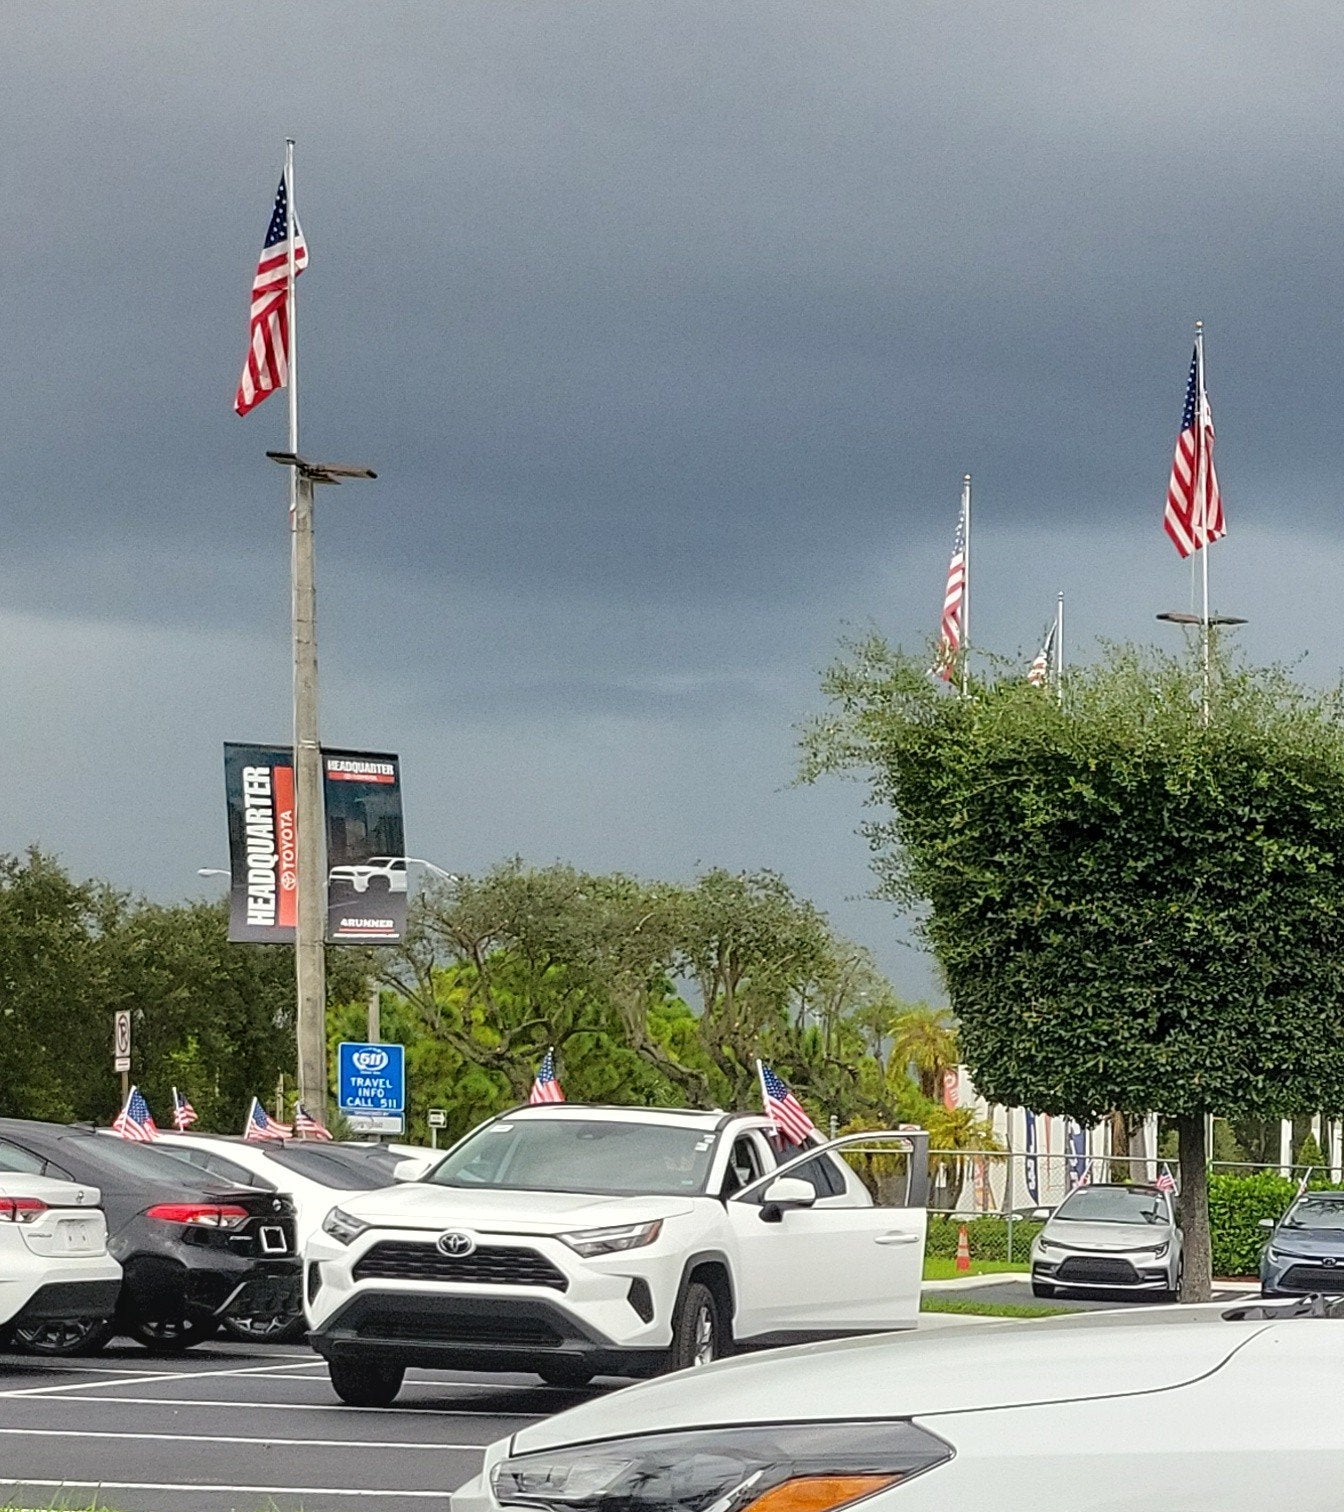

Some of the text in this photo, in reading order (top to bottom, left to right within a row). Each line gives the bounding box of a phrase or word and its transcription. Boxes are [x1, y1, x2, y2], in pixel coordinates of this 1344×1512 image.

[327, 760, 394, 775] HEADQUARTER
[243, 766, 278, 926] HEADQUARTER
[280, 810, 296, 868] TOYOTA
[359, 1051, 382, 1066] 511
[350, 1077, 393, 1089] TRAVEL
[358, 1087, 385, 1098] INFO
[346, 1097, 397, 1109] CALL 511
